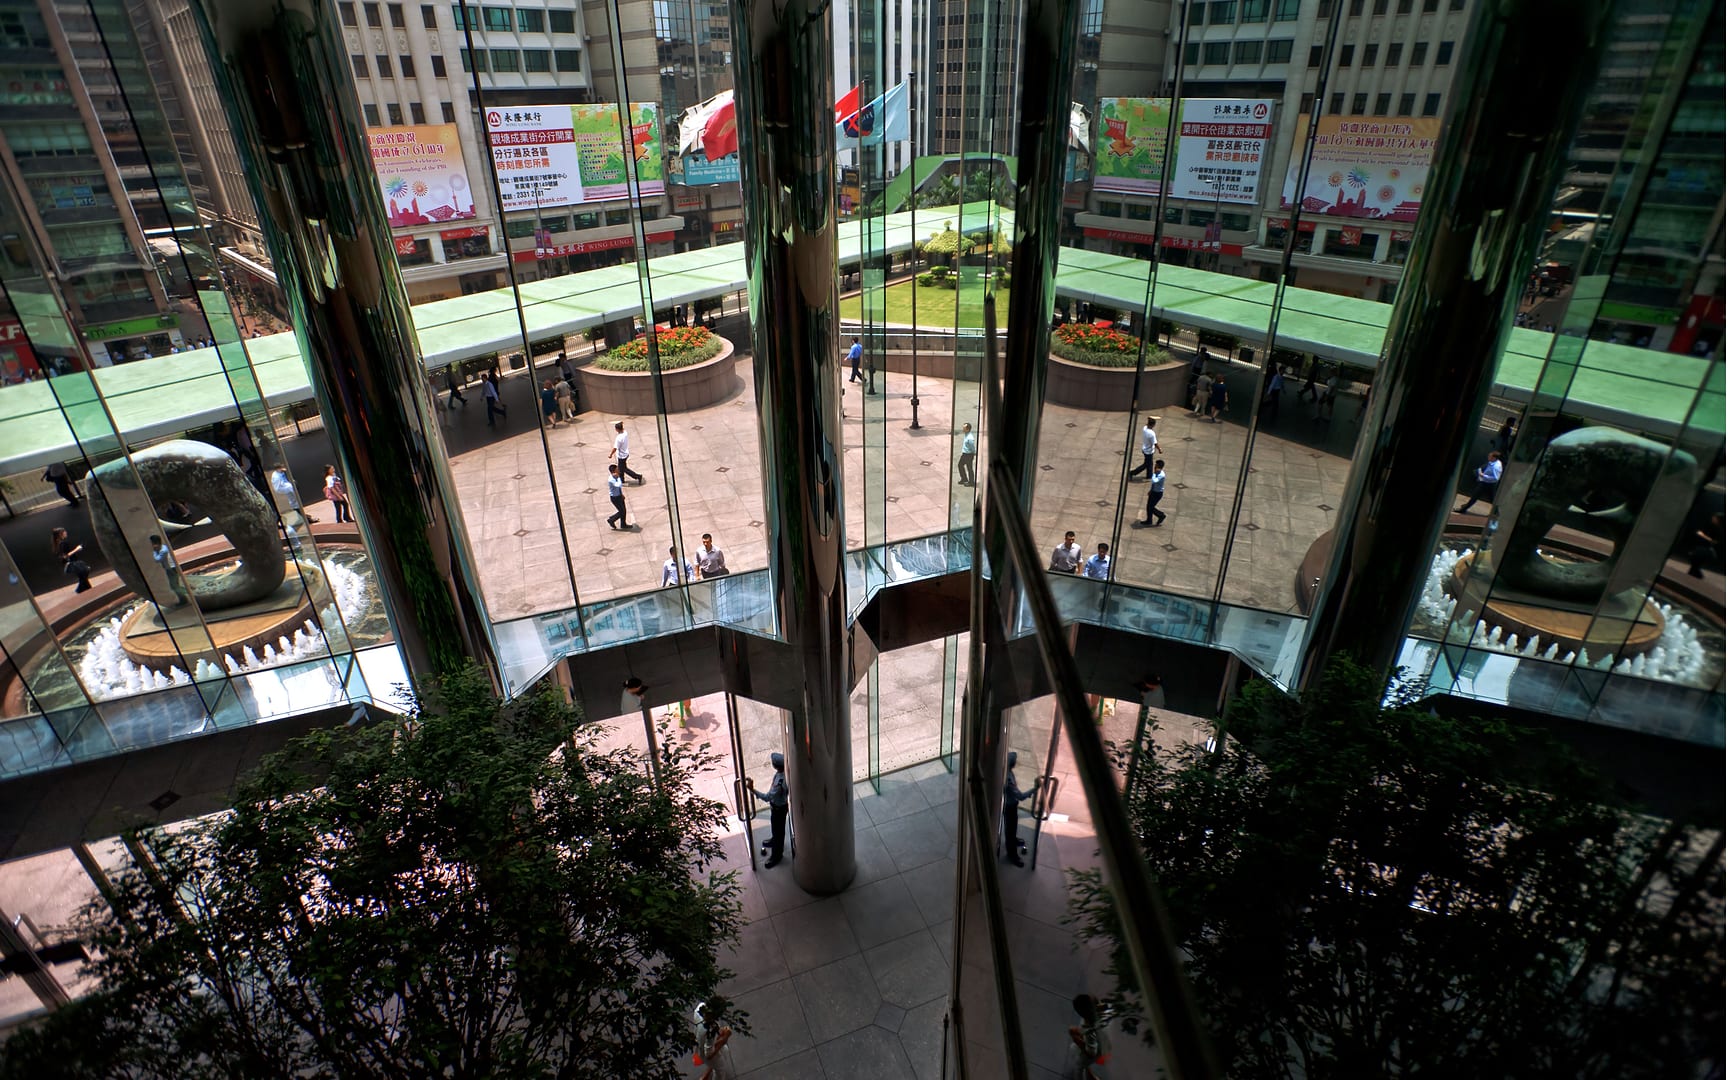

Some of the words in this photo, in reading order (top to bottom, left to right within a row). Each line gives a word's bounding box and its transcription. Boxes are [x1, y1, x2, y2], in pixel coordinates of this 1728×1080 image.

[505, 112, 542, 122] 永隆銀行
[491, 130, 573, 144] 觀塘成業街分行開業
